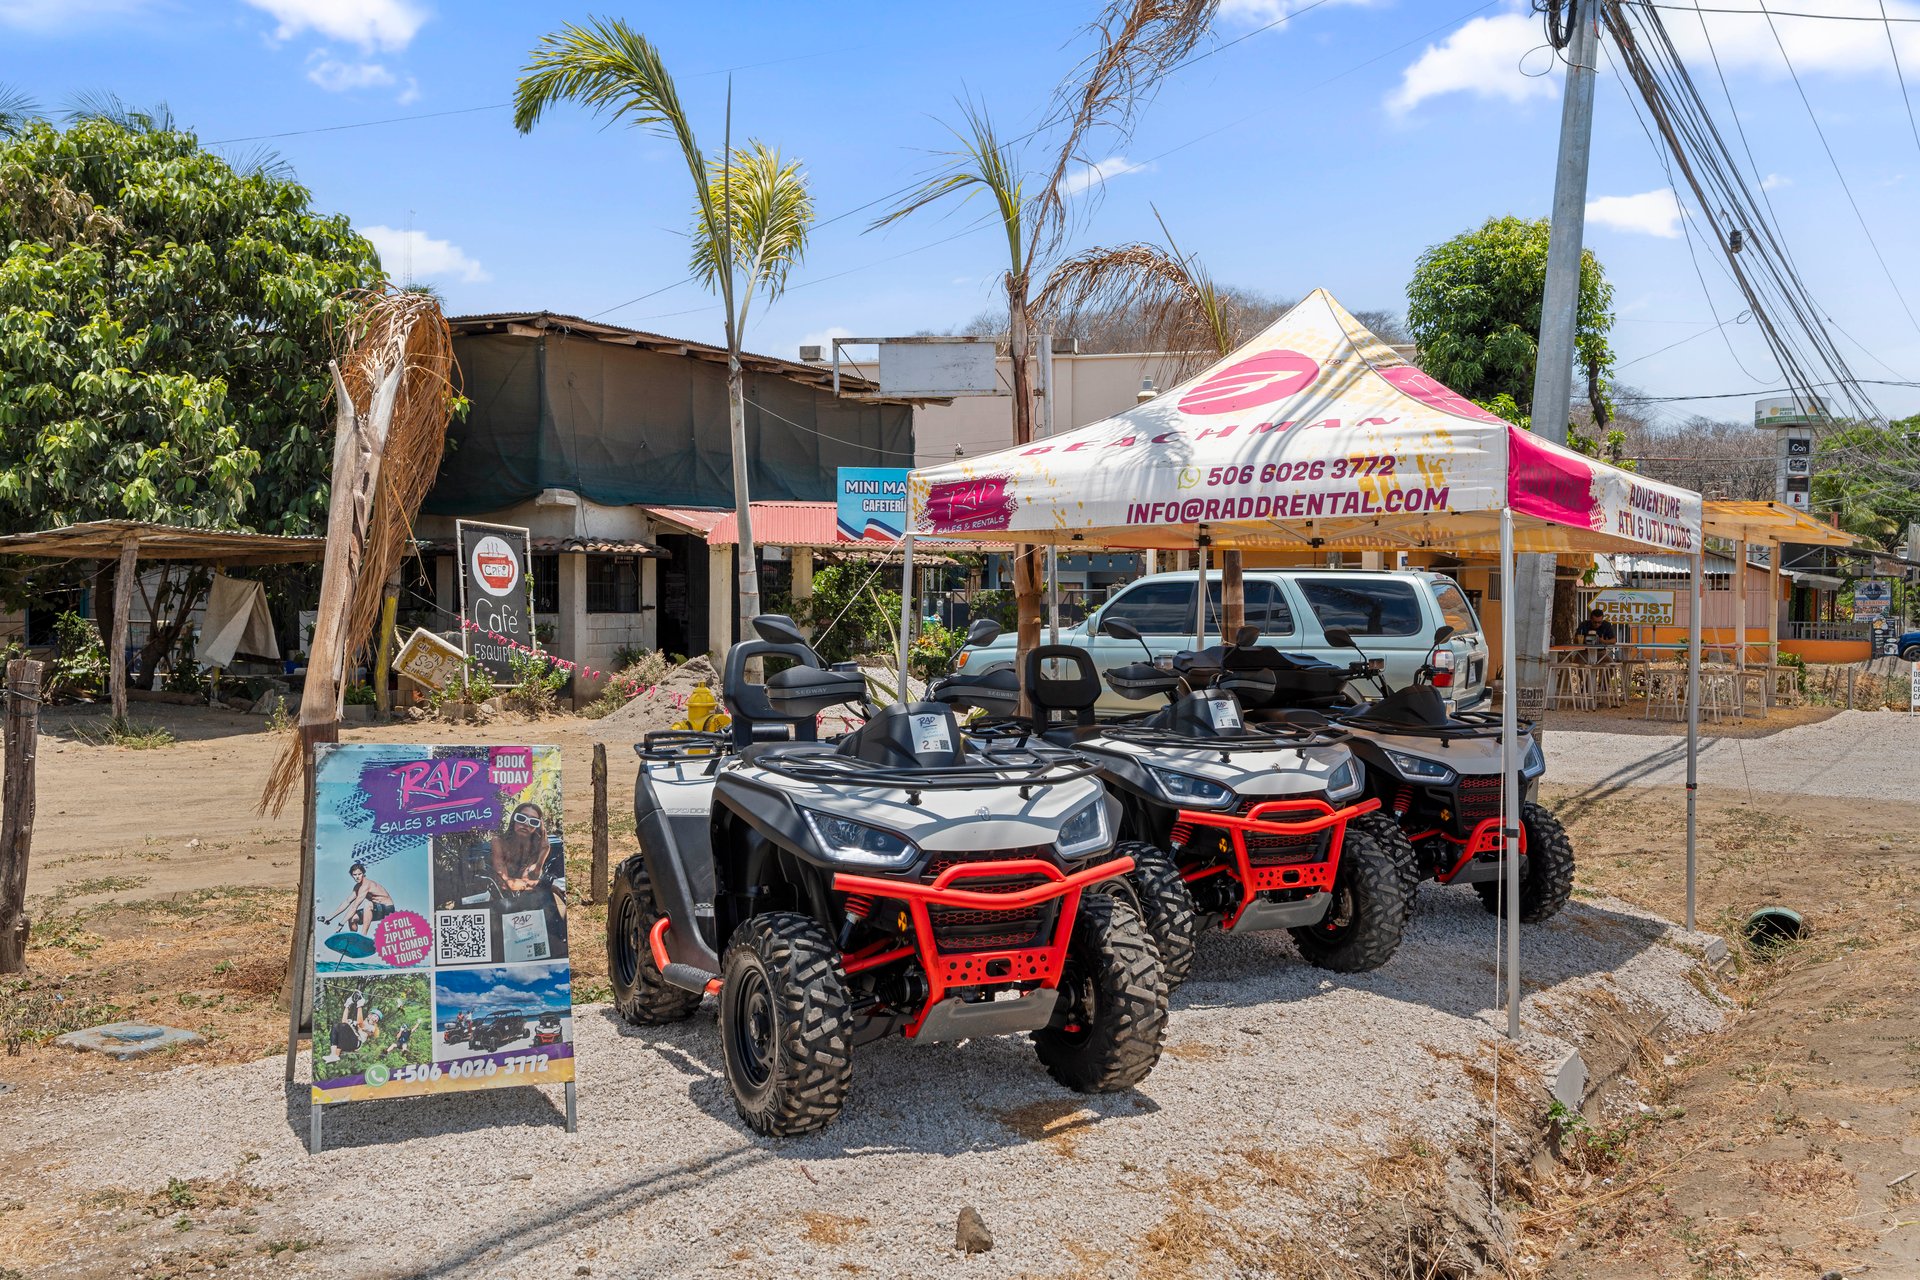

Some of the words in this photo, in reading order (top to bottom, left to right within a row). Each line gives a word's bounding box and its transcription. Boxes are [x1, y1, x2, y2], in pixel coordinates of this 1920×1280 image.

[1018, 417, 1401, 457] BEACHMAN
[1207, 465, 1255, 486] 506
[1259, 460, 1325, 484] 6026
[1331, 455, 1396, 479] 3772
[845, 480, 879, 494] MINI
[944, 483, 996, 519] RAD
[1127, 487, 1451, 524] INFO@RADDRENTAL.COM
[1629, 483, 1681, 519] ADVENTURE
[937, 525, 961, 535] SALES
[972, 515, 1005, 528] RENTALS
[1618, 510, 1635, 537] ATV
[1638, 515, 1644, 539] &
[1645, 518, 1663, 543] UTV
[1664, 523, 1692, 550] TOURS
[475, 598, 519, 634] Café
[1595, 601, 1672, 615] DENTIST
[1603, 613, 1672, 624] 2653-2020
[795, 687, 828, 696] SEGWAY
[987, 690, 1014, 698] SEGWAY
[916, 716, 936, 727] RAD
[922, 740, 931, 750] 2
[496, 755, 526, 769] BOOK
[387, 760, 480, 810] RAD
[492, 770, 530, 785] TODAY
[379, 817, 422, 834] SALES
[426, 816, 437, 829] &
[440, 807, 493, 826] RENTALS
[384, 916, 412, 932] E-FOIL
[512, 914, 532, 929] RAD
[384, 927, 417, 944] ZIPLINE
[381, 943, 398, 957] ATV
[399, 936, 430, 952] COMBO
[395, 949, 423, 964] TOURS
[393, 1063, 442, 1084] +506
[448, 1058, 497, 1080] 6026
[504, 1053, 549, 1076] 3772
